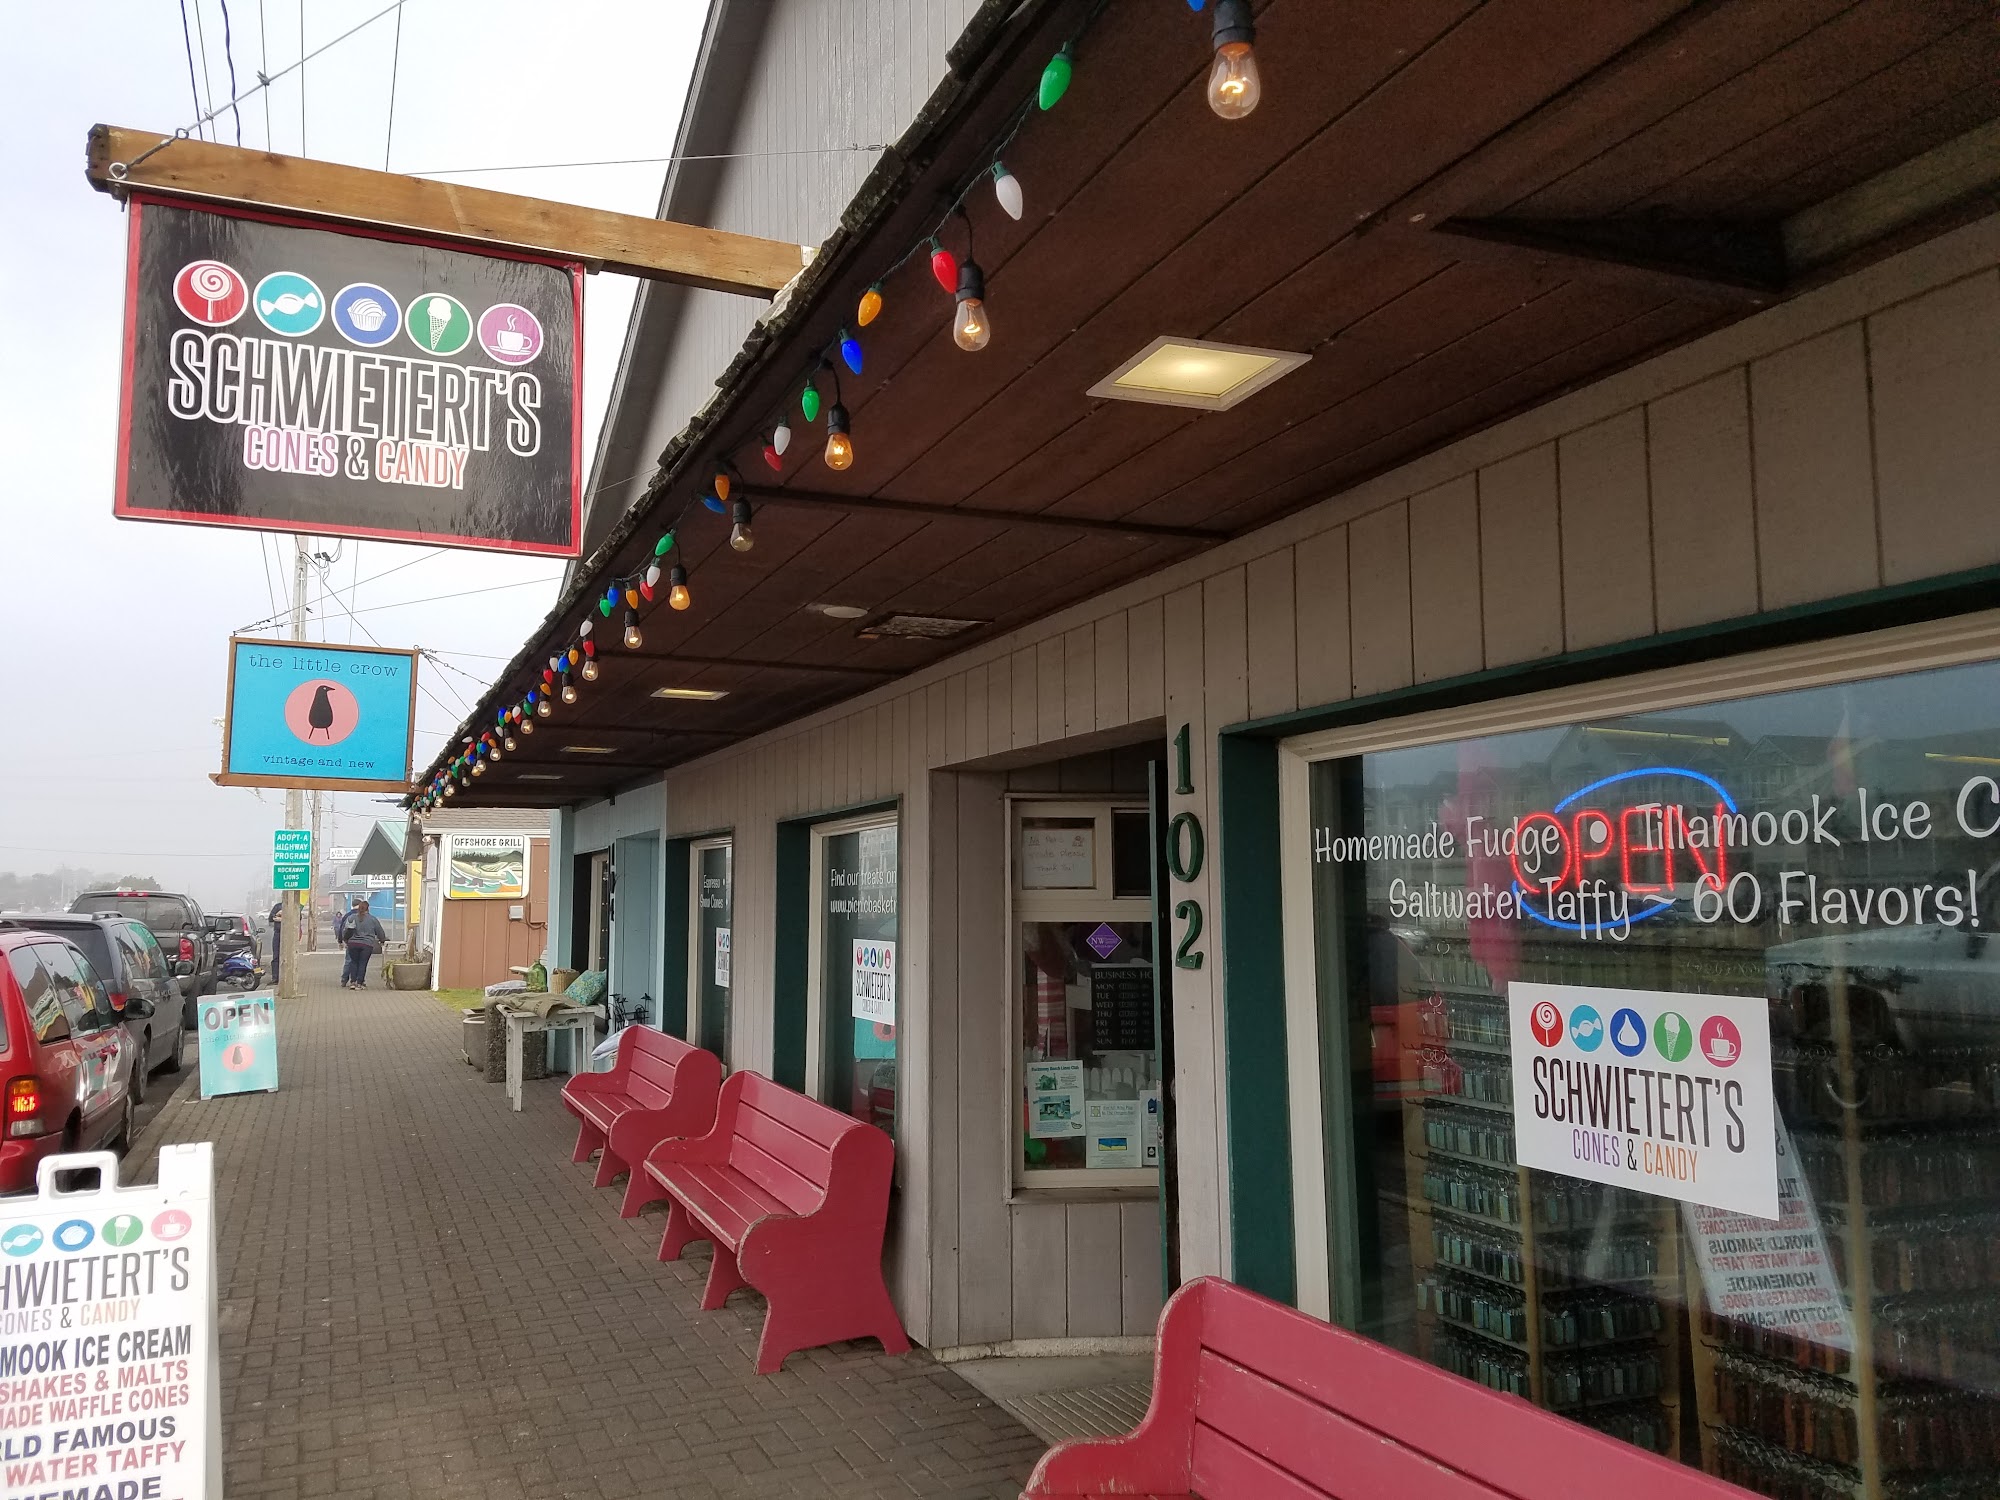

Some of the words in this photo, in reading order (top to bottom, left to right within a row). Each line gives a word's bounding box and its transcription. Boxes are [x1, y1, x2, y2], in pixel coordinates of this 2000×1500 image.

[167, 327, 542, 458] SCHWIETERT'S
[243, 425, 338, 478] CONES
[345, 437, 369, 480] &
[376, 439, 469, 490] CANDY
[249, 653, 283, 668] the
[292, 656, 341, 673] little
[350, 664, 398, 677] crow
[263, 754, 314, 767] vintage
[317, 757, 342, 768] and
[348, 759, 375, 769] new
[454, 838, 496, 847] OFFSHORE
[499, 838, 521, 847] GRILL
[1315, 822, 1455, 863] Homemade
[1466, 815, 1560, 874] Fudge
[1636, 793, 1841, 850] Tillamook
[1858, 787, 1932, 842] Ice
[275, 852, 309, 860] PROGRAM
[831, 868, 846, 887] Find
[847, 873, 859, 887] our
[859, 868, 884, 886] treats
[886, 869, 897, 884] on
[1389, 877, 1527, 921] Saltwater
[1539, 875, 1631, 942] Taffy
[1692, 871, 1761, 924] 60
[1779, 868, 1980, 928] Flavors!
[855, 969, 891, 1002] SCHWIETERT'S
[1095, 971, 1137, 980] BUSINESS
[1096, 992, 1110, 1000] TUE
[1096, 1010, 1112, 1018] THU
[204, 1002, 270, 1031] OPEN
[1532, 1055, 1746, 1154] SCHWIETERT'S
[1572, 1128, 1620, 1168] CONES
[1627, 1138, 1638, 1171] &
[1643, 1141, 1698, 1184] CANDY
[60, 1306, 72, 1329] &
[80, 1298, 141, 1326] CANDY
[74, 1334, 110, 1368] ICE
[117, 1324, 192, 1363] CREAM
[0, 1372, 87, 1405] SHAKES
[94, 1369, 109, 1392] &
[117, 1359, 189, 1389] MALTS
[49, 1392, 122, 1423] WAFFLE
[128, 1383, 189, 1412] CONES
[0, 1434, 42, 1462] LD
[53, 1415, 176, 1453] FAMOUS
[6, 1453, 98, 1488] WATER
[106, 1440, 186, 1472] TAFFY
